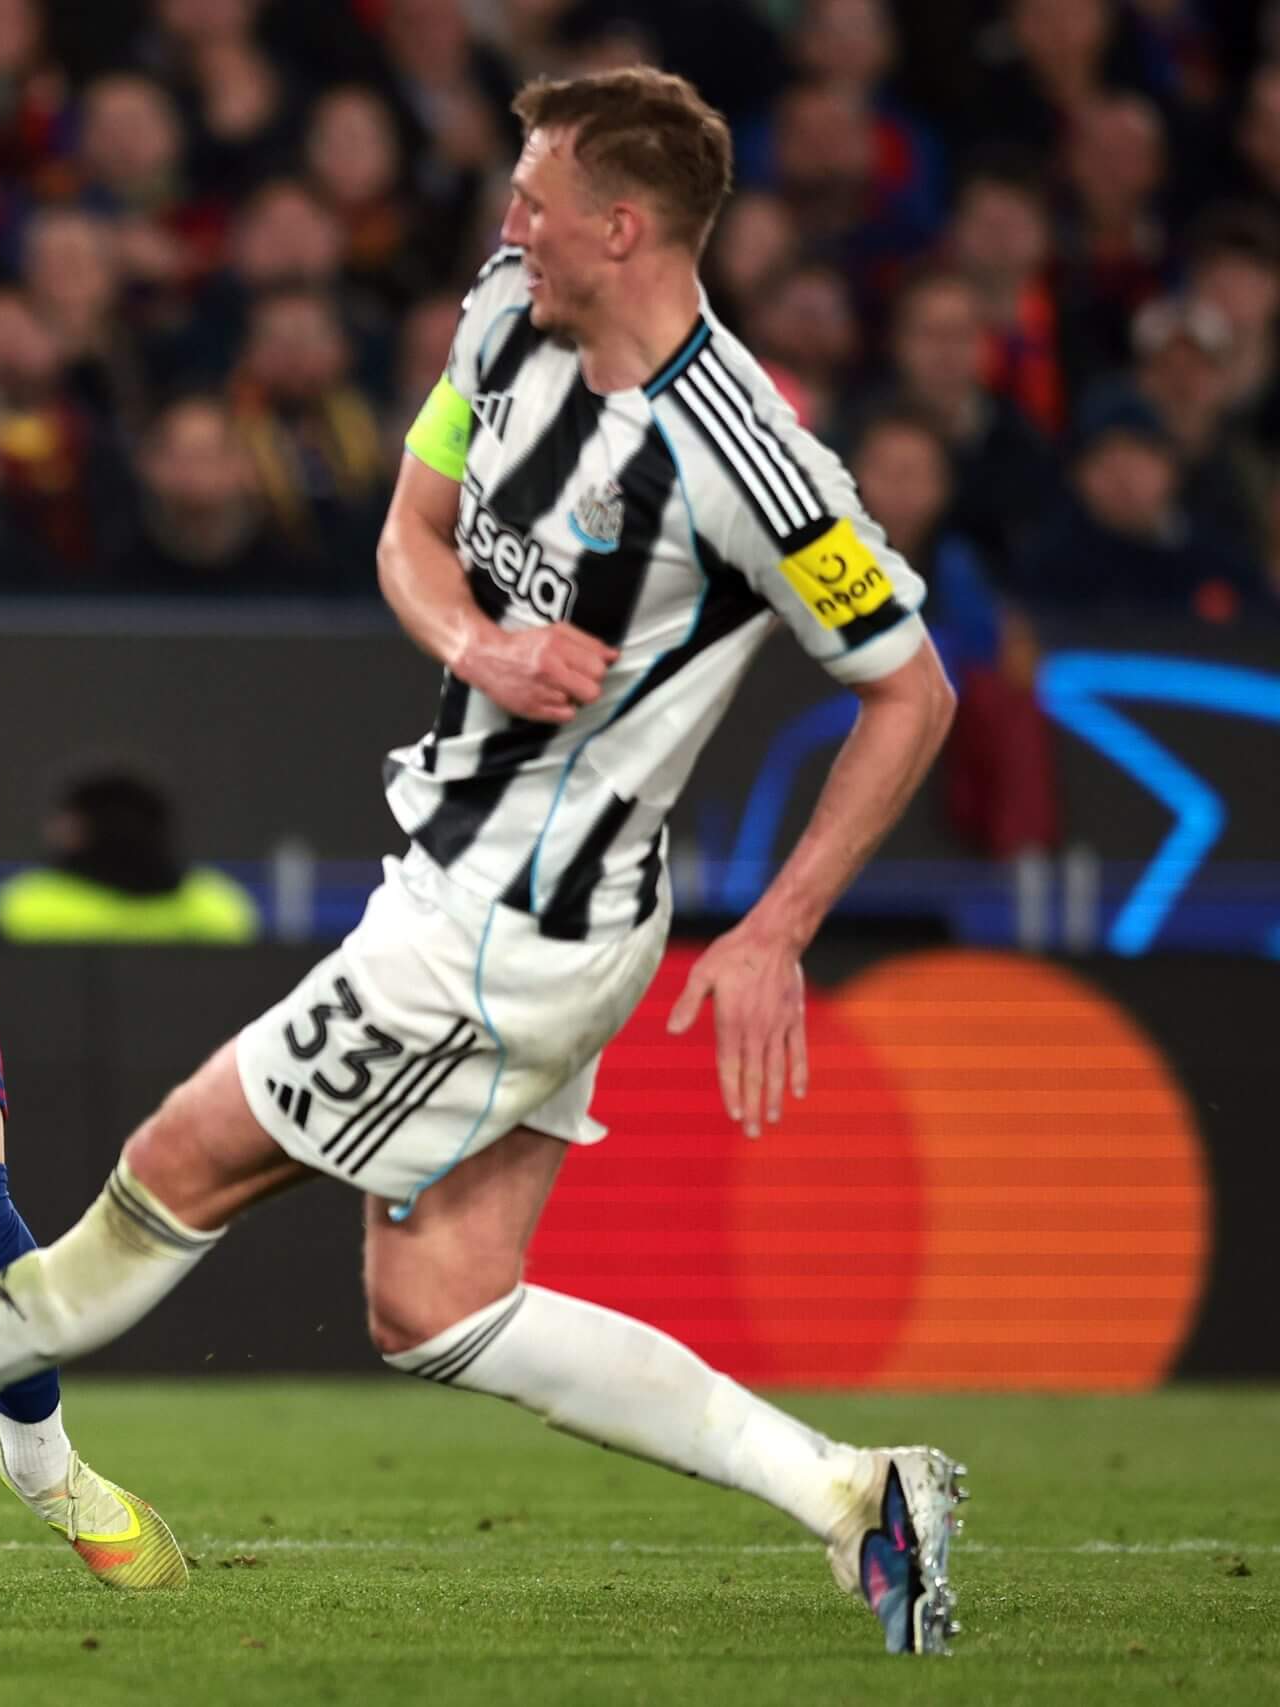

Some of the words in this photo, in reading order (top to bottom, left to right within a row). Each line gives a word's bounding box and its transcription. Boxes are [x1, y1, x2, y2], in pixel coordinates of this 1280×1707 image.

[470, 509, 572, 622] sela
[815, 566, 883, 616] noon
[283, 975, 404, 1100] 33
